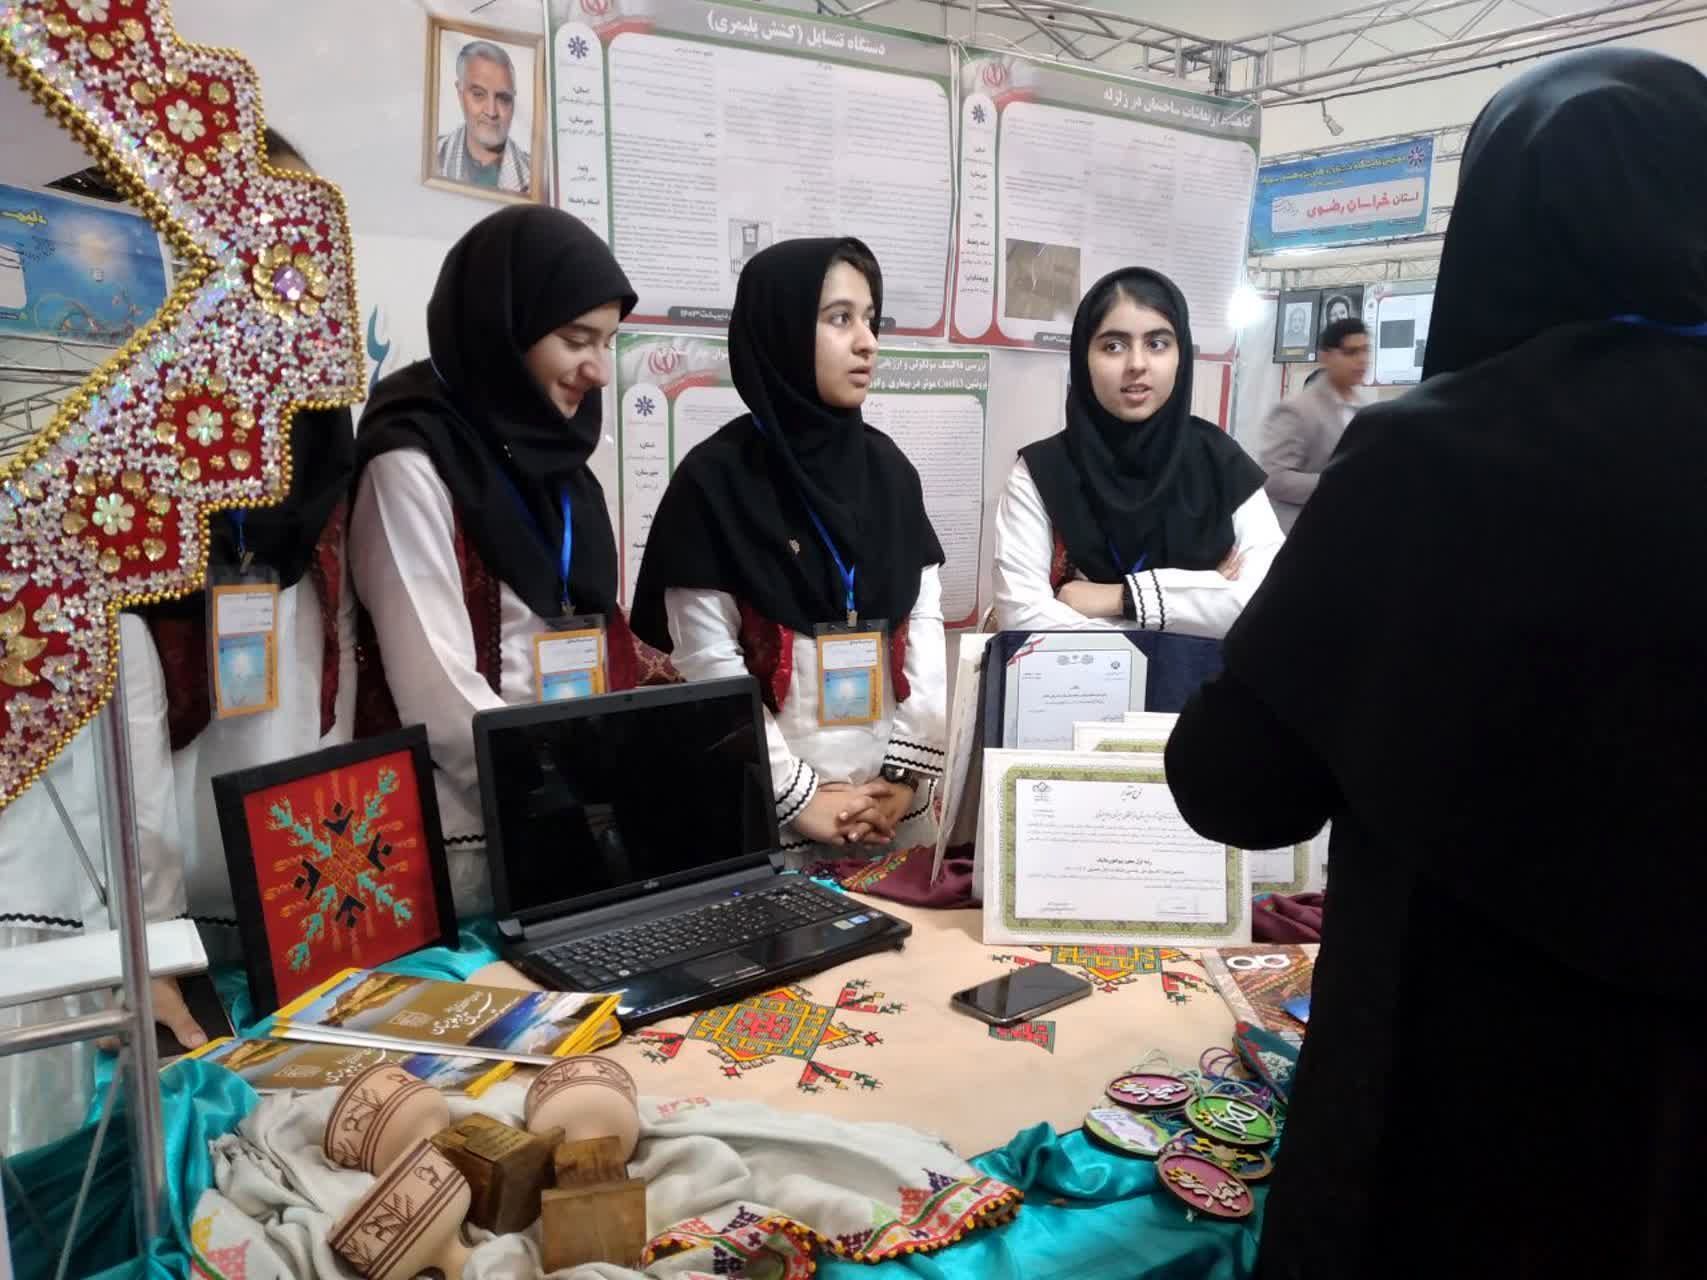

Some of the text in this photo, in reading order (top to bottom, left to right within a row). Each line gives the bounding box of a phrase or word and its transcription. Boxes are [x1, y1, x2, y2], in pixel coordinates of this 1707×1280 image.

[847, 34, 886, 56] دستگاه
[1306, 191, 1419, 219] استان خراسان رضوی
